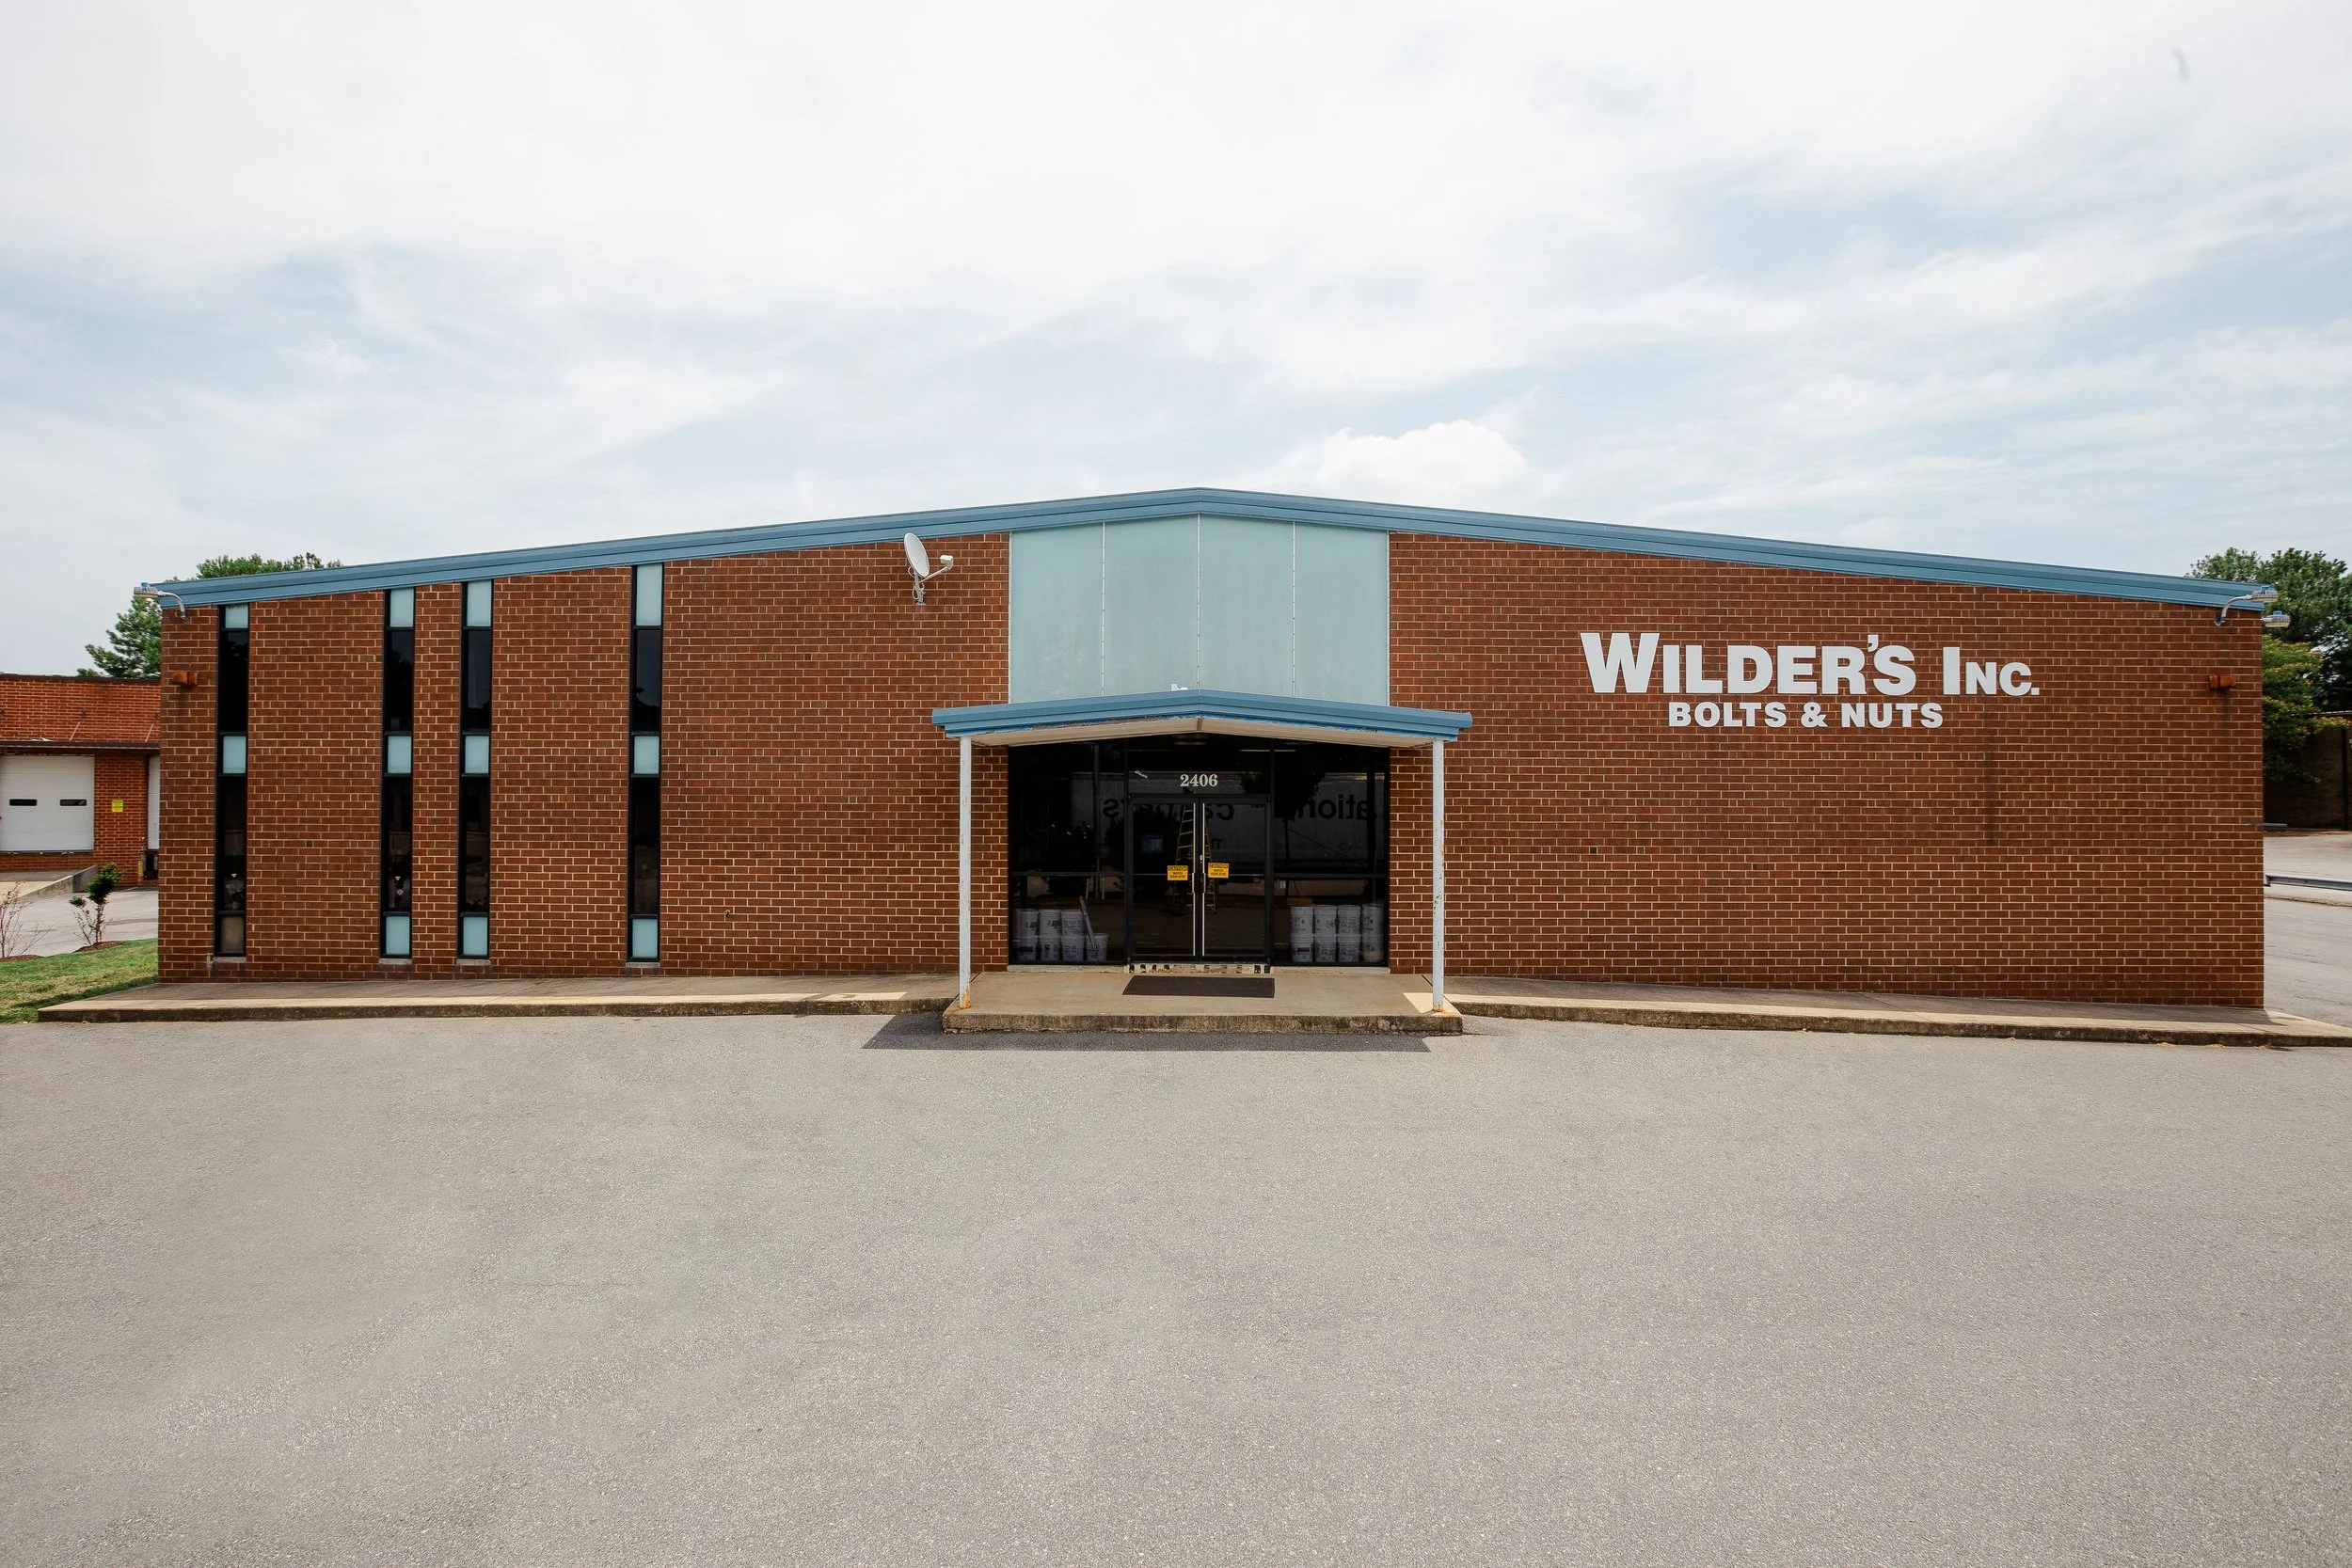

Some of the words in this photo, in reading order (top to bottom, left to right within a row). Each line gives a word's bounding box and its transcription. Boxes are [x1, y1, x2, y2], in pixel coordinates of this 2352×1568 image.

[1581, 632, 1917, 696] WILDER'S
[1942, 646, 2040, 697] INC.
[1668, 701, 1788, 728] BOLTS
[1801, 702, 1828, 728] &
[1840, 702, 1944, 729] NUTS
[1180, 773, 1218, 787] 2406
